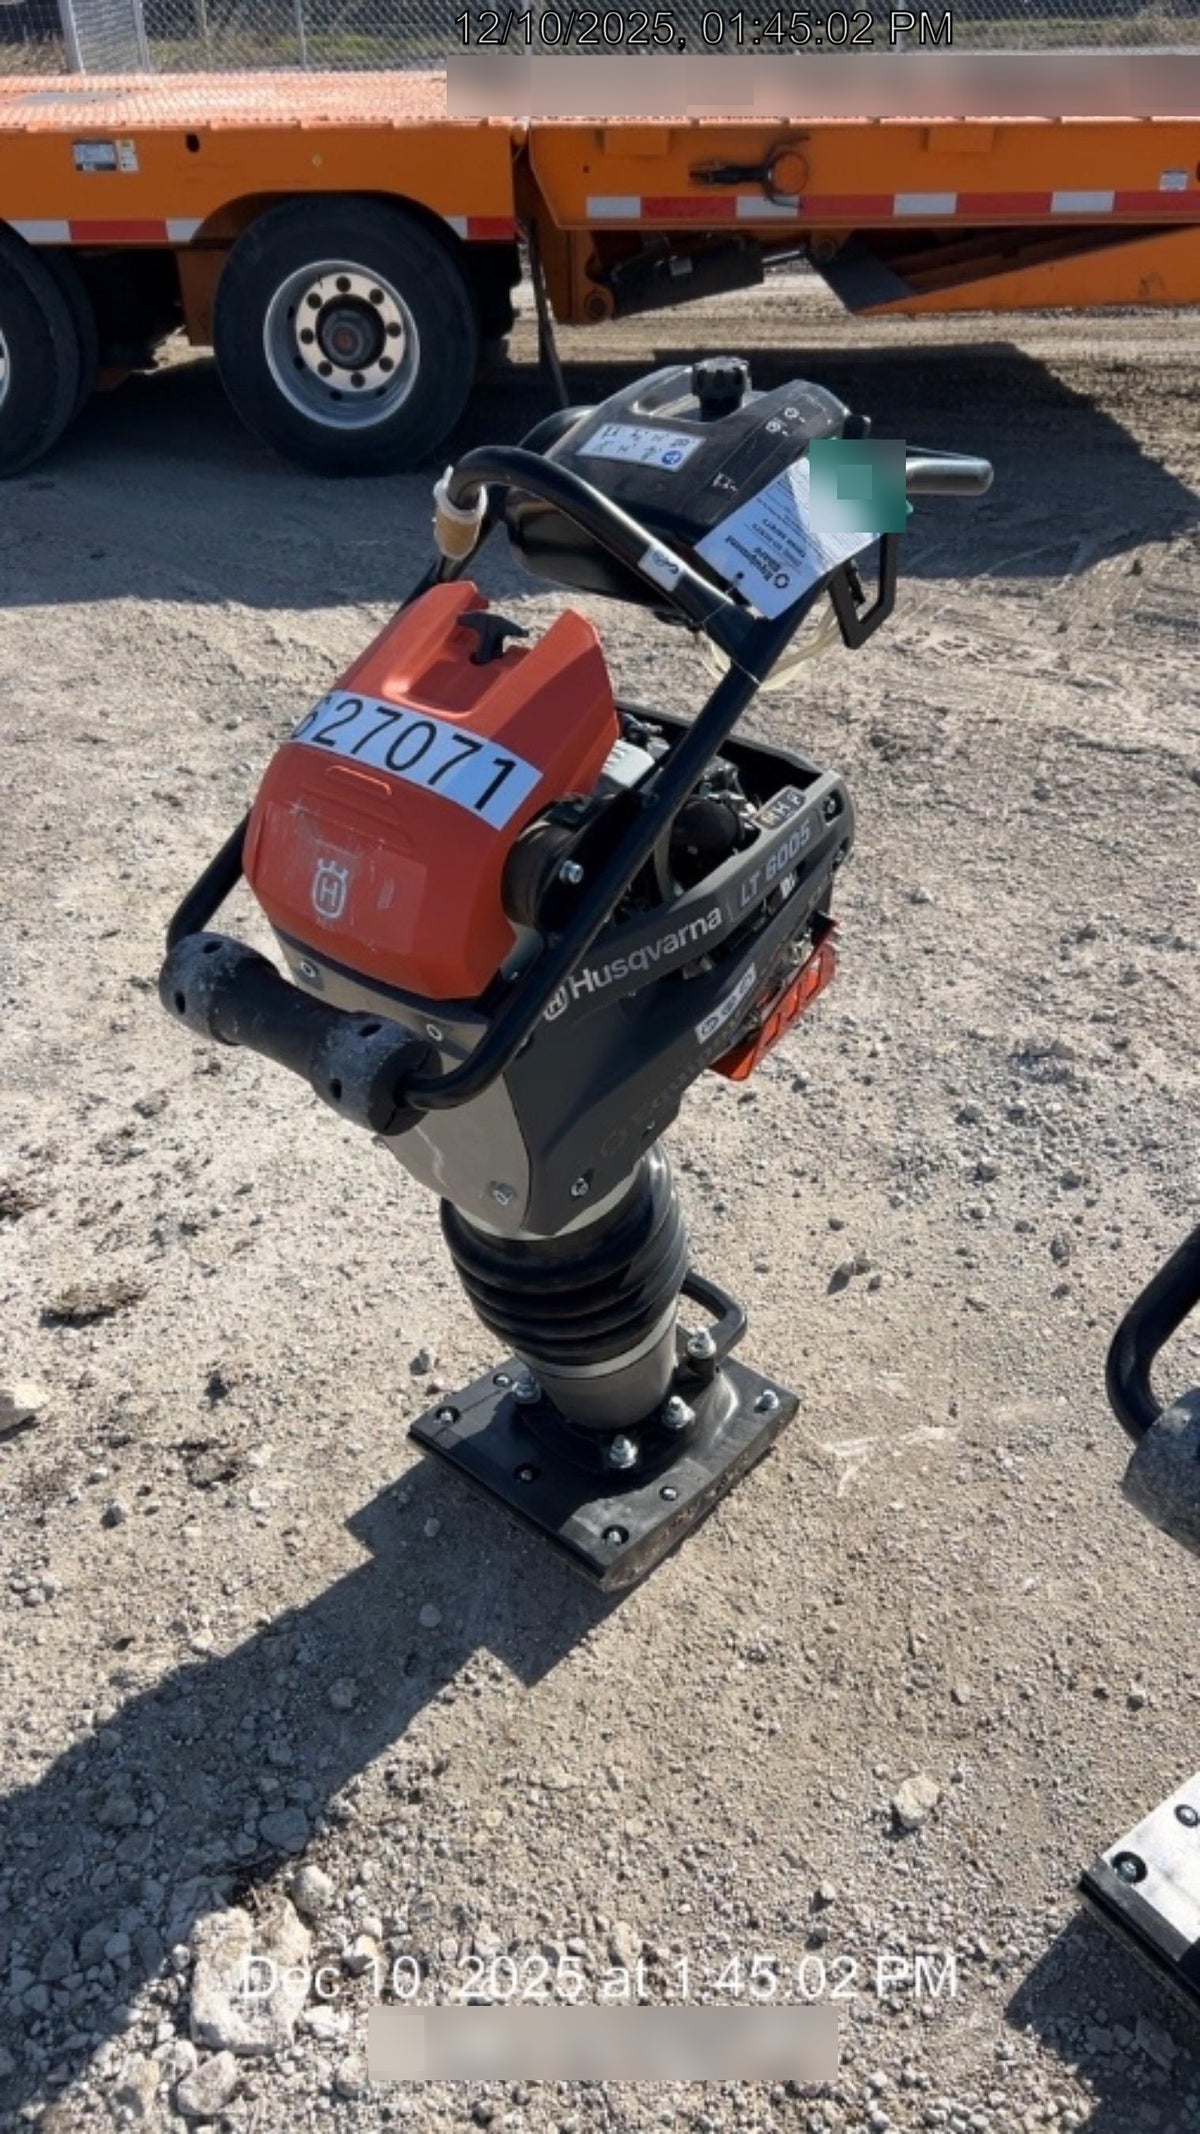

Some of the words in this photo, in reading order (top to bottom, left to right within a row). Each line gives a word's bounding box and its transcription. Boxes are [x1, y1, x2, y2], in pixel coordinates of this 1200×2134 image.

[741, 870, 760, 907] LT
[764, 818, 811, 881] 6005
[569, 906, 723, 1000] Husqvarna
